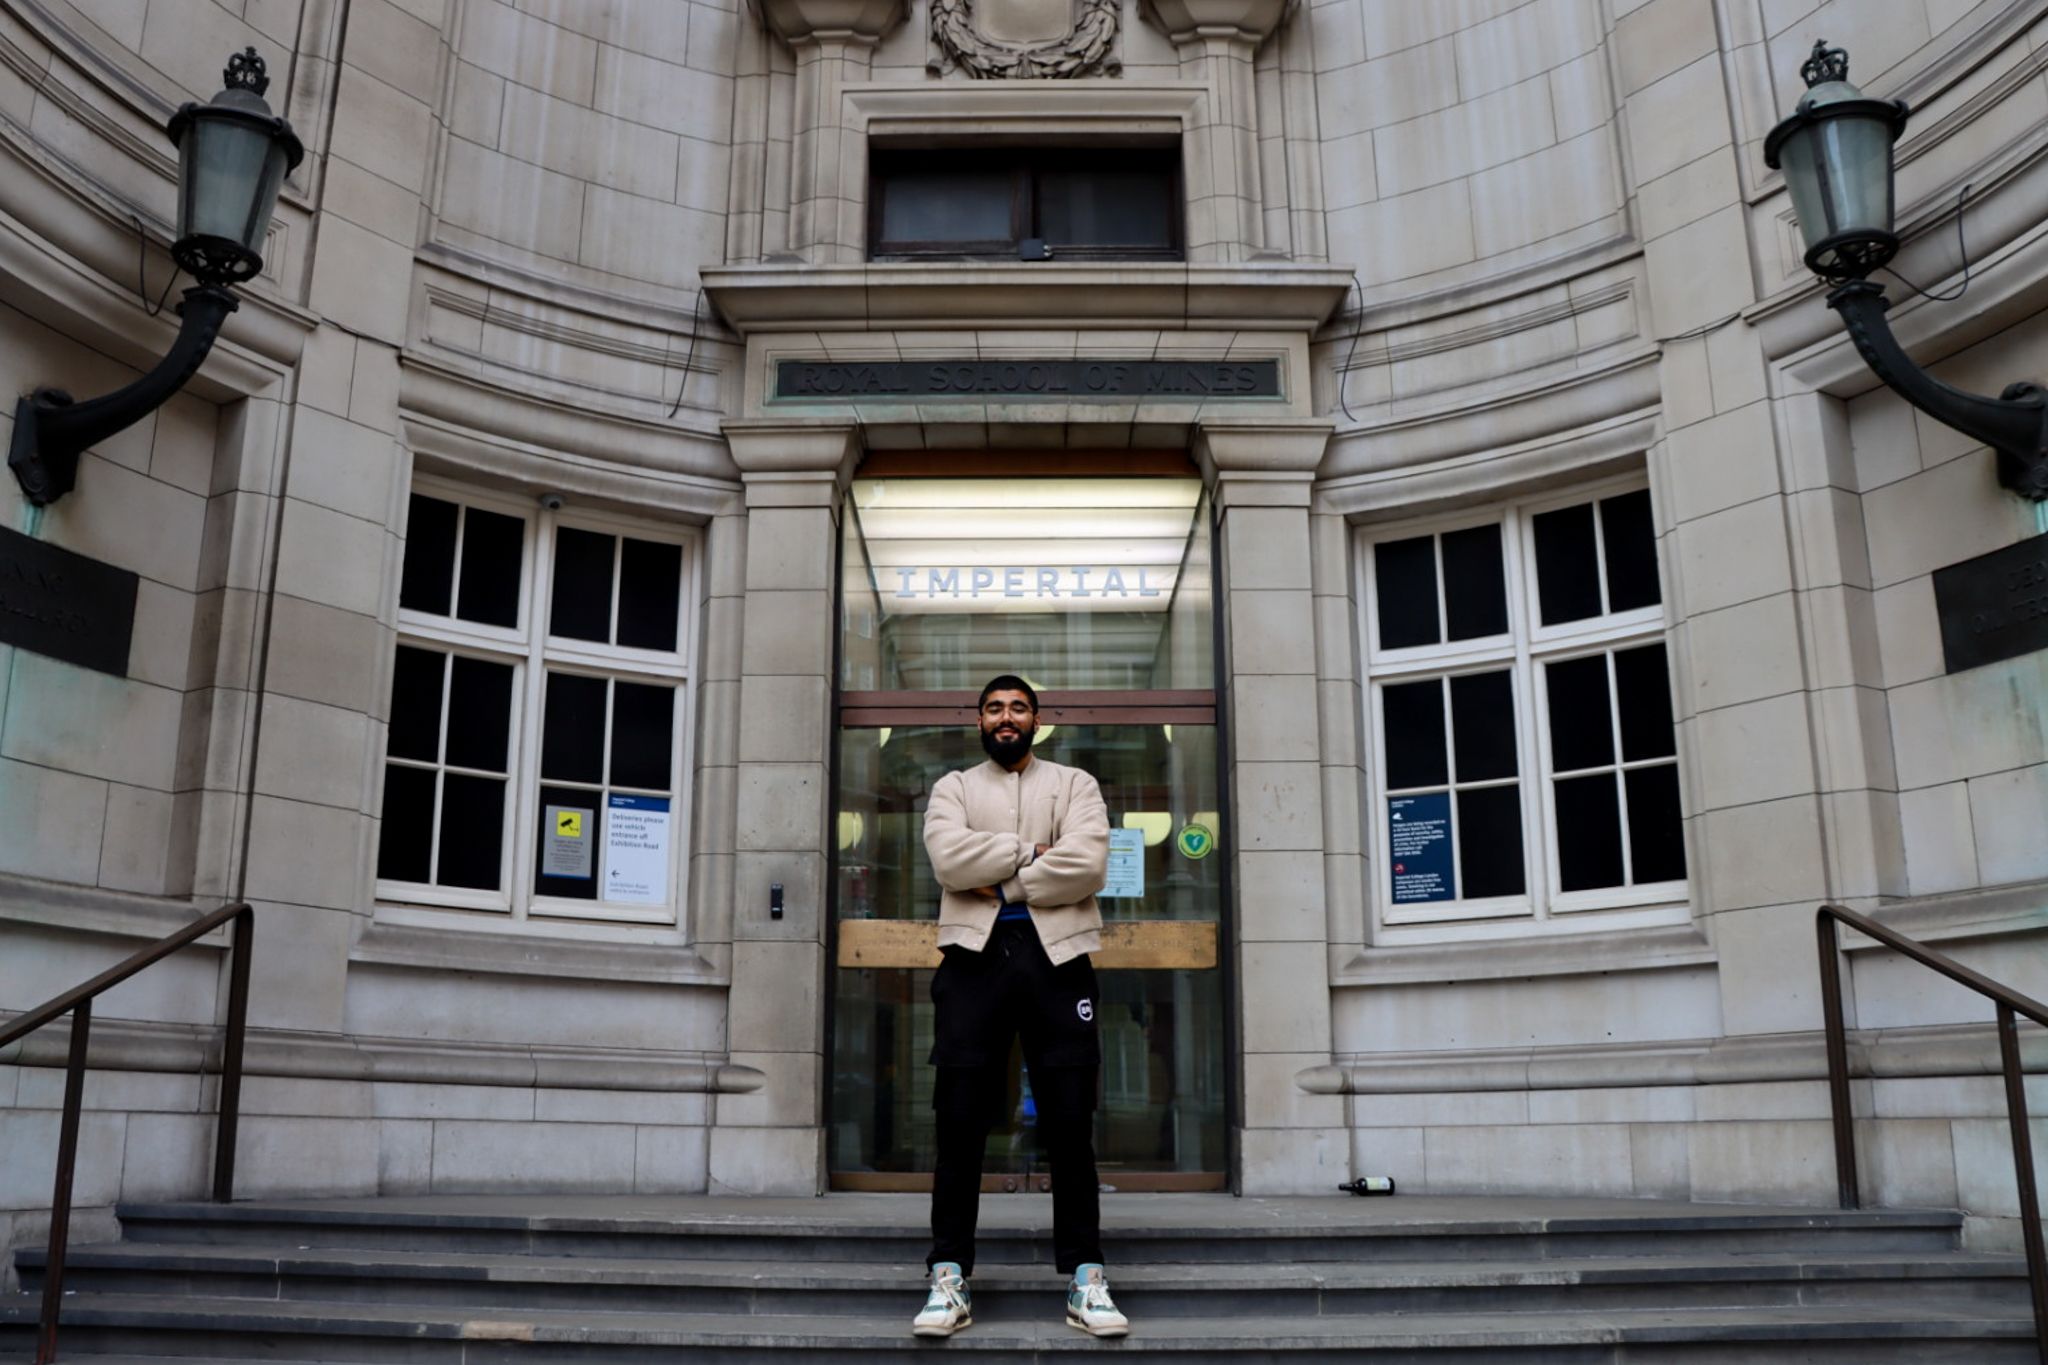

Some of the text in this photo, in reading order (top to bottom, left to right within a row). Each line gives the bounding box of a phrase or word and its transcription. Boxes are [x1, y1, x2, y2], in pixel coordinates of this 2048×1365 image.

[797, 365, 1258, 393] ROYAL SCHOOL OF MINES
[896, 567, 1160, 598] IMPERIAL
